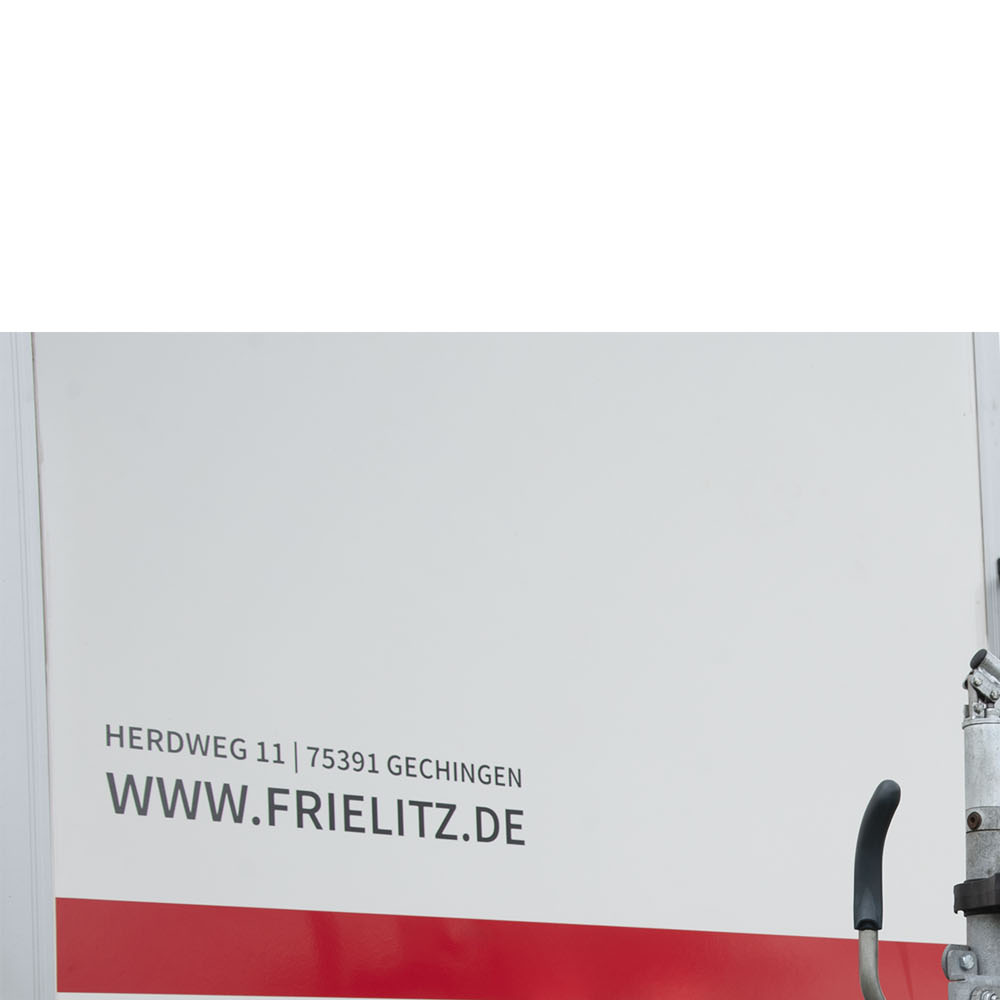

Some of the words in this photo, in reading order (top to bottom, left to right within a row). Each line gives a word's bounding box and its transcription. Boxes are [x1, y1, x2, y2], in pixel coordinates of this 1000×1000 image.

[105, 724, 247, 761] HERDWEG
[256, 741, 285, 765] 11
[306, 746, 380, 774] 75391
[387, 755, 523, 789] GECHINGEN
[106, 772, 526, 846] WWW.FRIELITZ.DE
